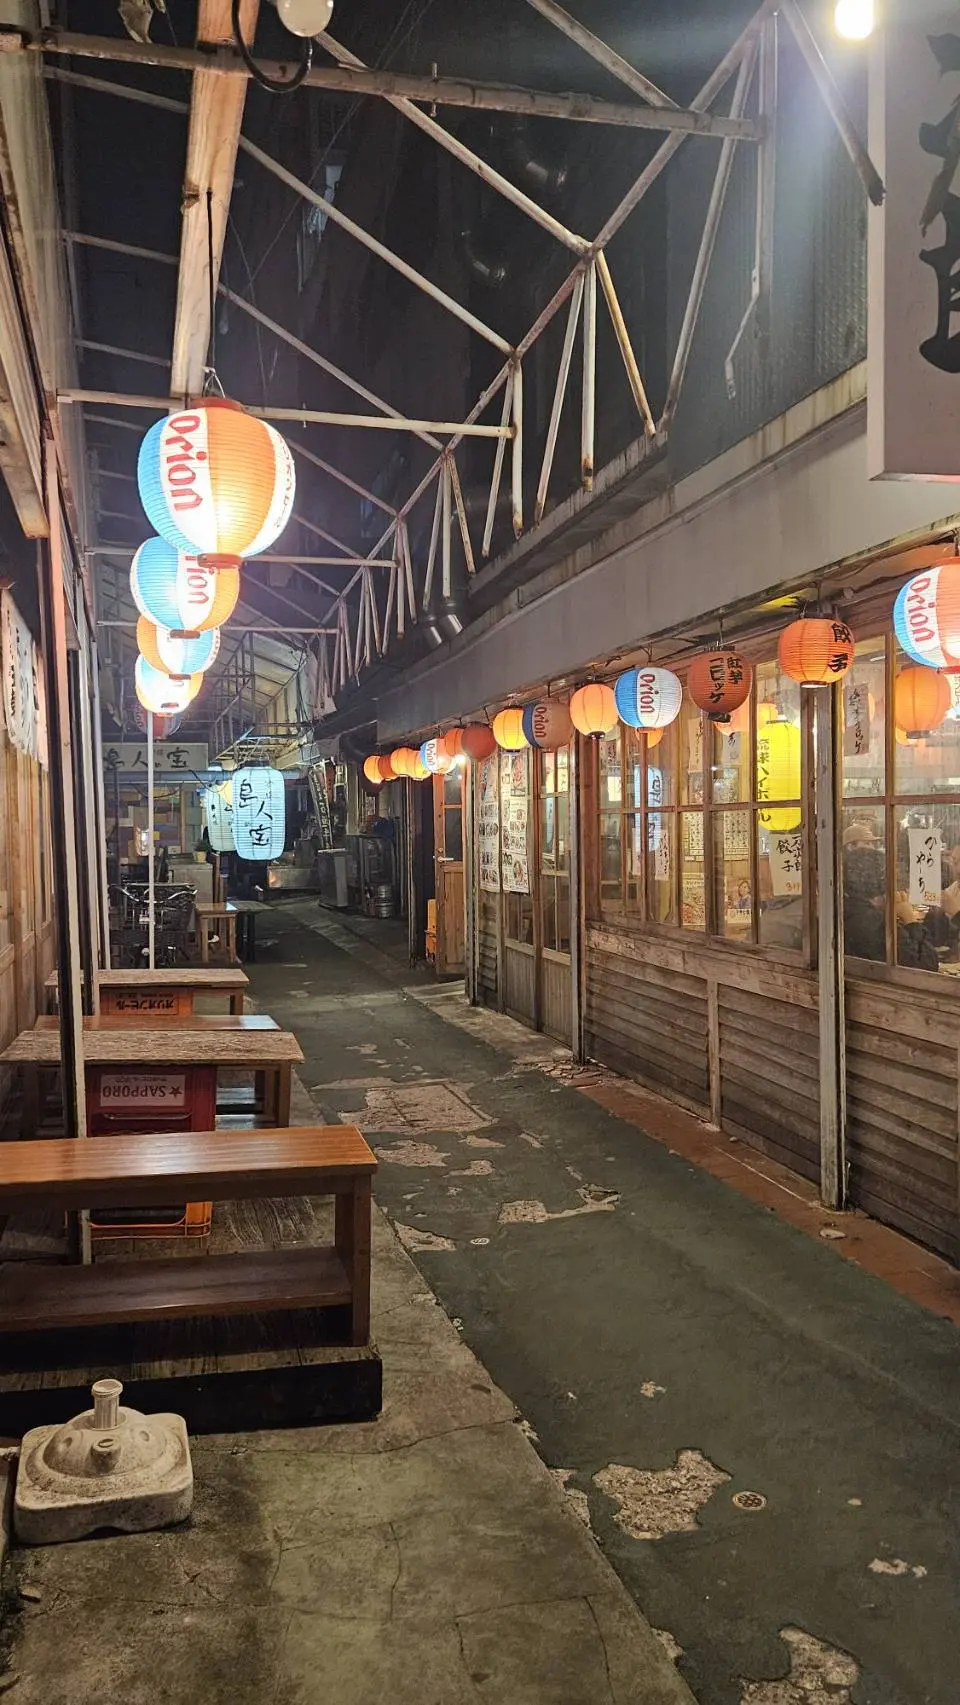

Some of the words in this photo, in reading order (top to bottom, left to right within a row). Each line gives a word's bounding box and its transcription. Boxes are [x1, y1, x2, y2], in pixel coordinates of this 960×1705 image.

[165, 415, 207, 511] Orion
[907, 577, 936, 642] Orion
[640, 673, 660, 713] Orion
[534, 706, 550, 738] Orion
[102, 1085, 167, 1098] SAPPORO
